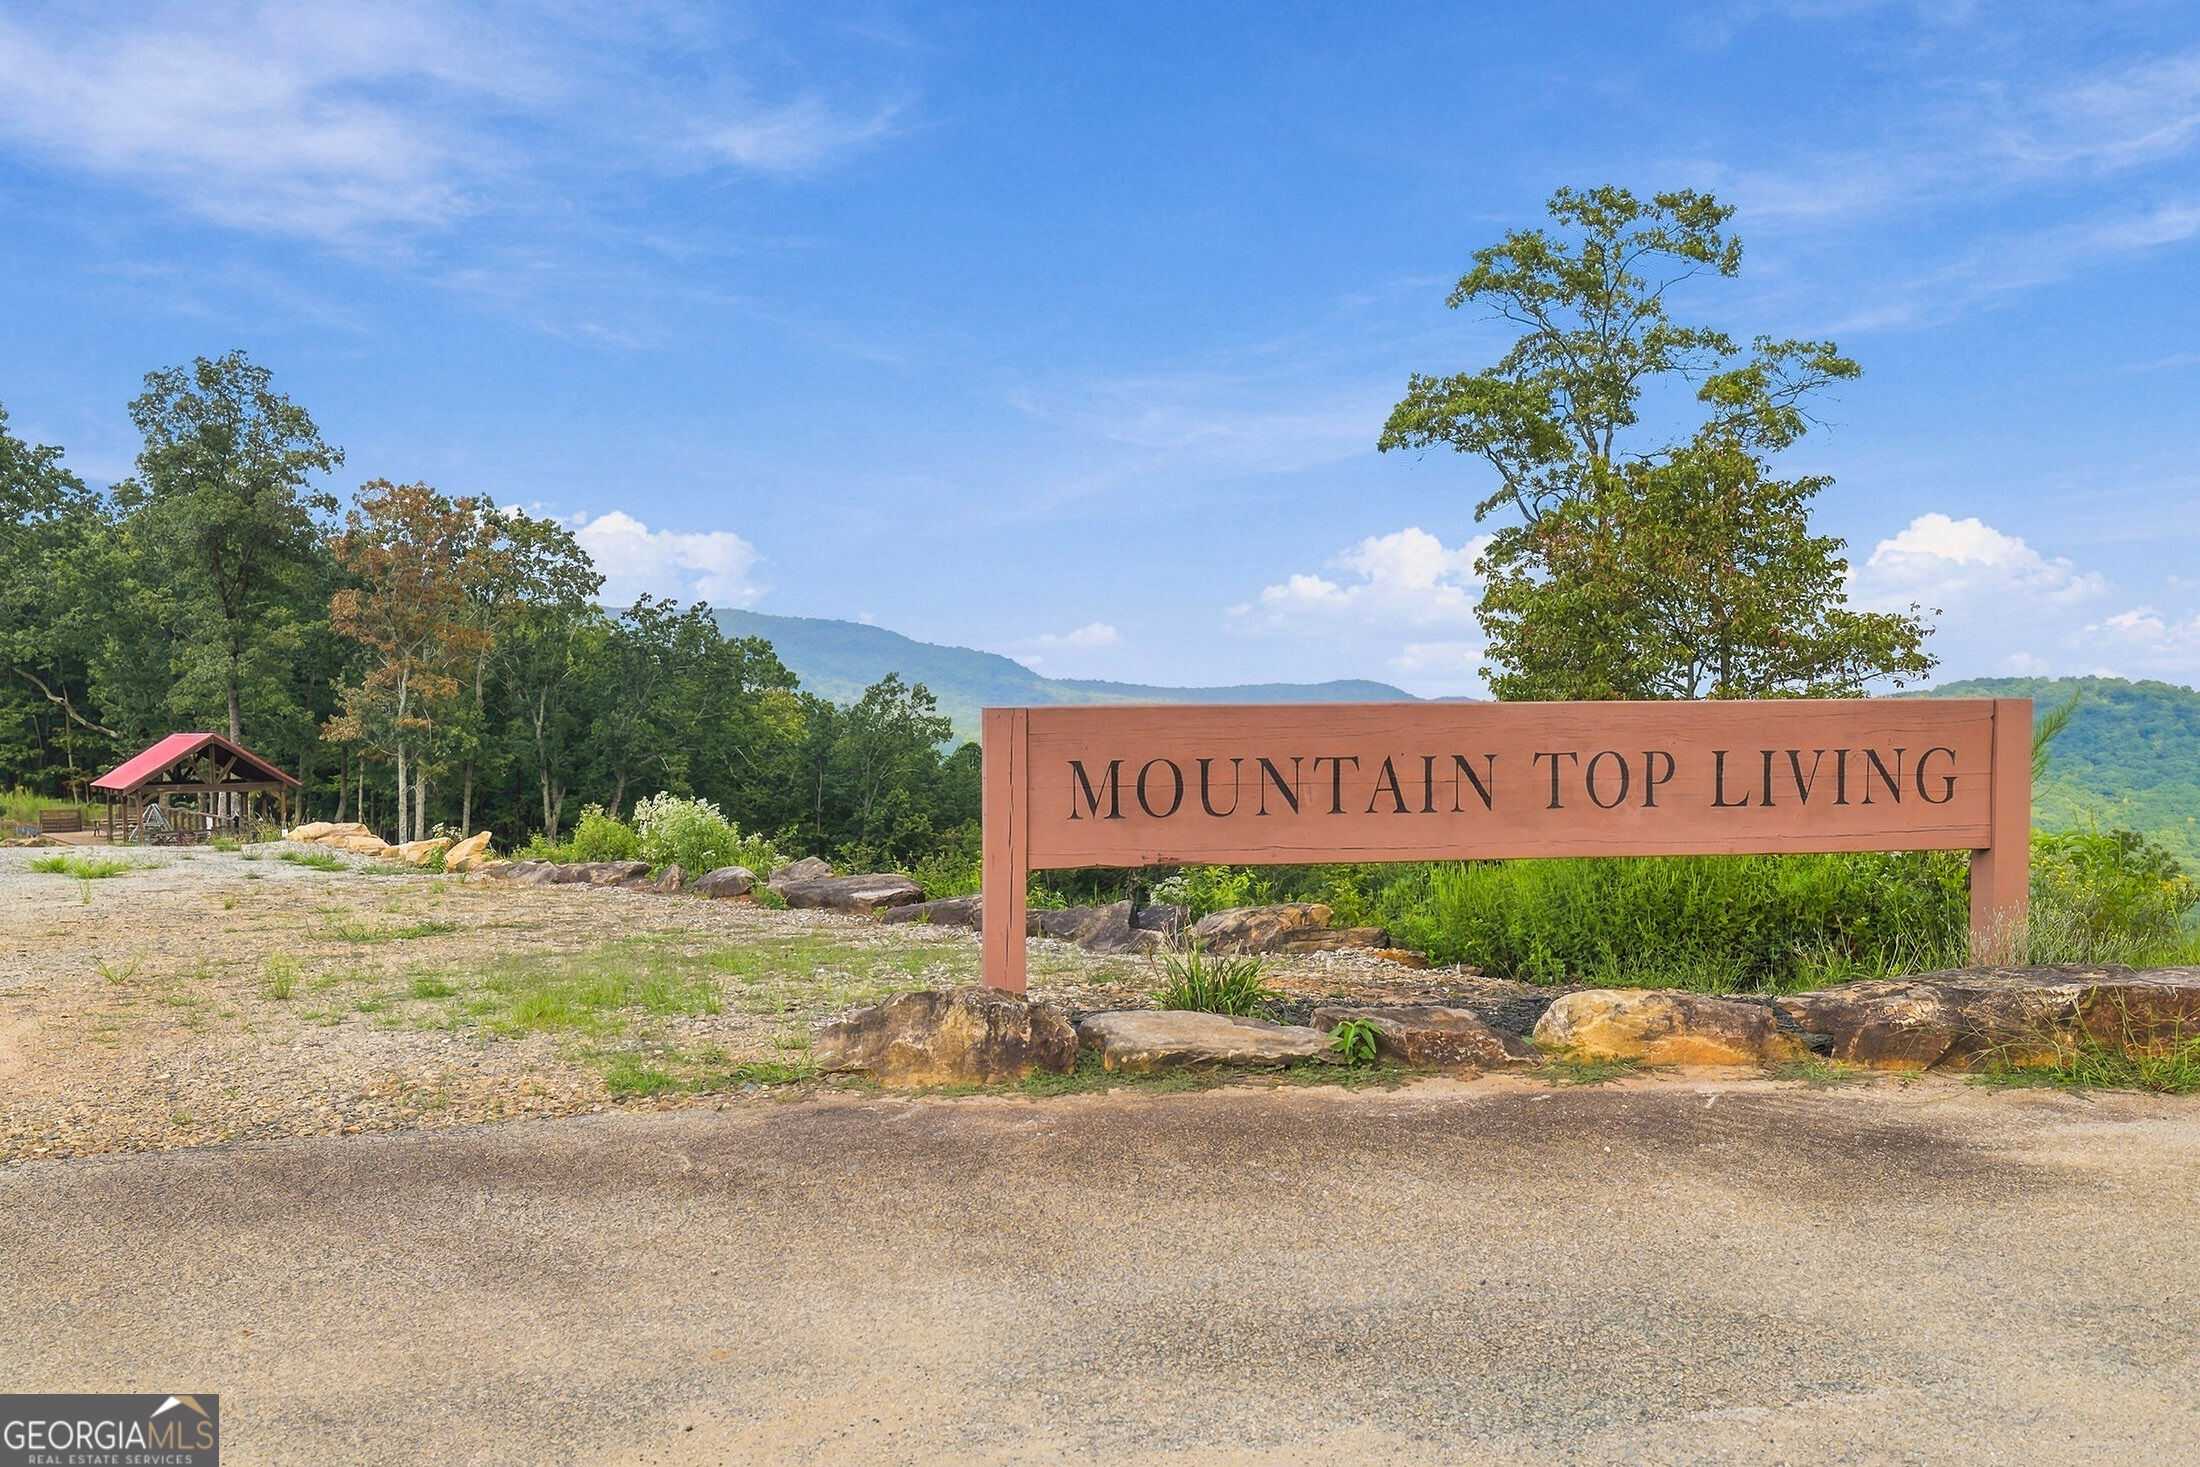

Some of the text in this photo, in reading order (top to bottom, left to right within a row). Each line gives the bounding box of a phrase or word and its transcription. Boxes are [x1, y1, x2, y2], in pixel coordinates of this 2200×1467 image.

[1067, 747, 1958, 820] MOUNTAIN TOP LIVING
